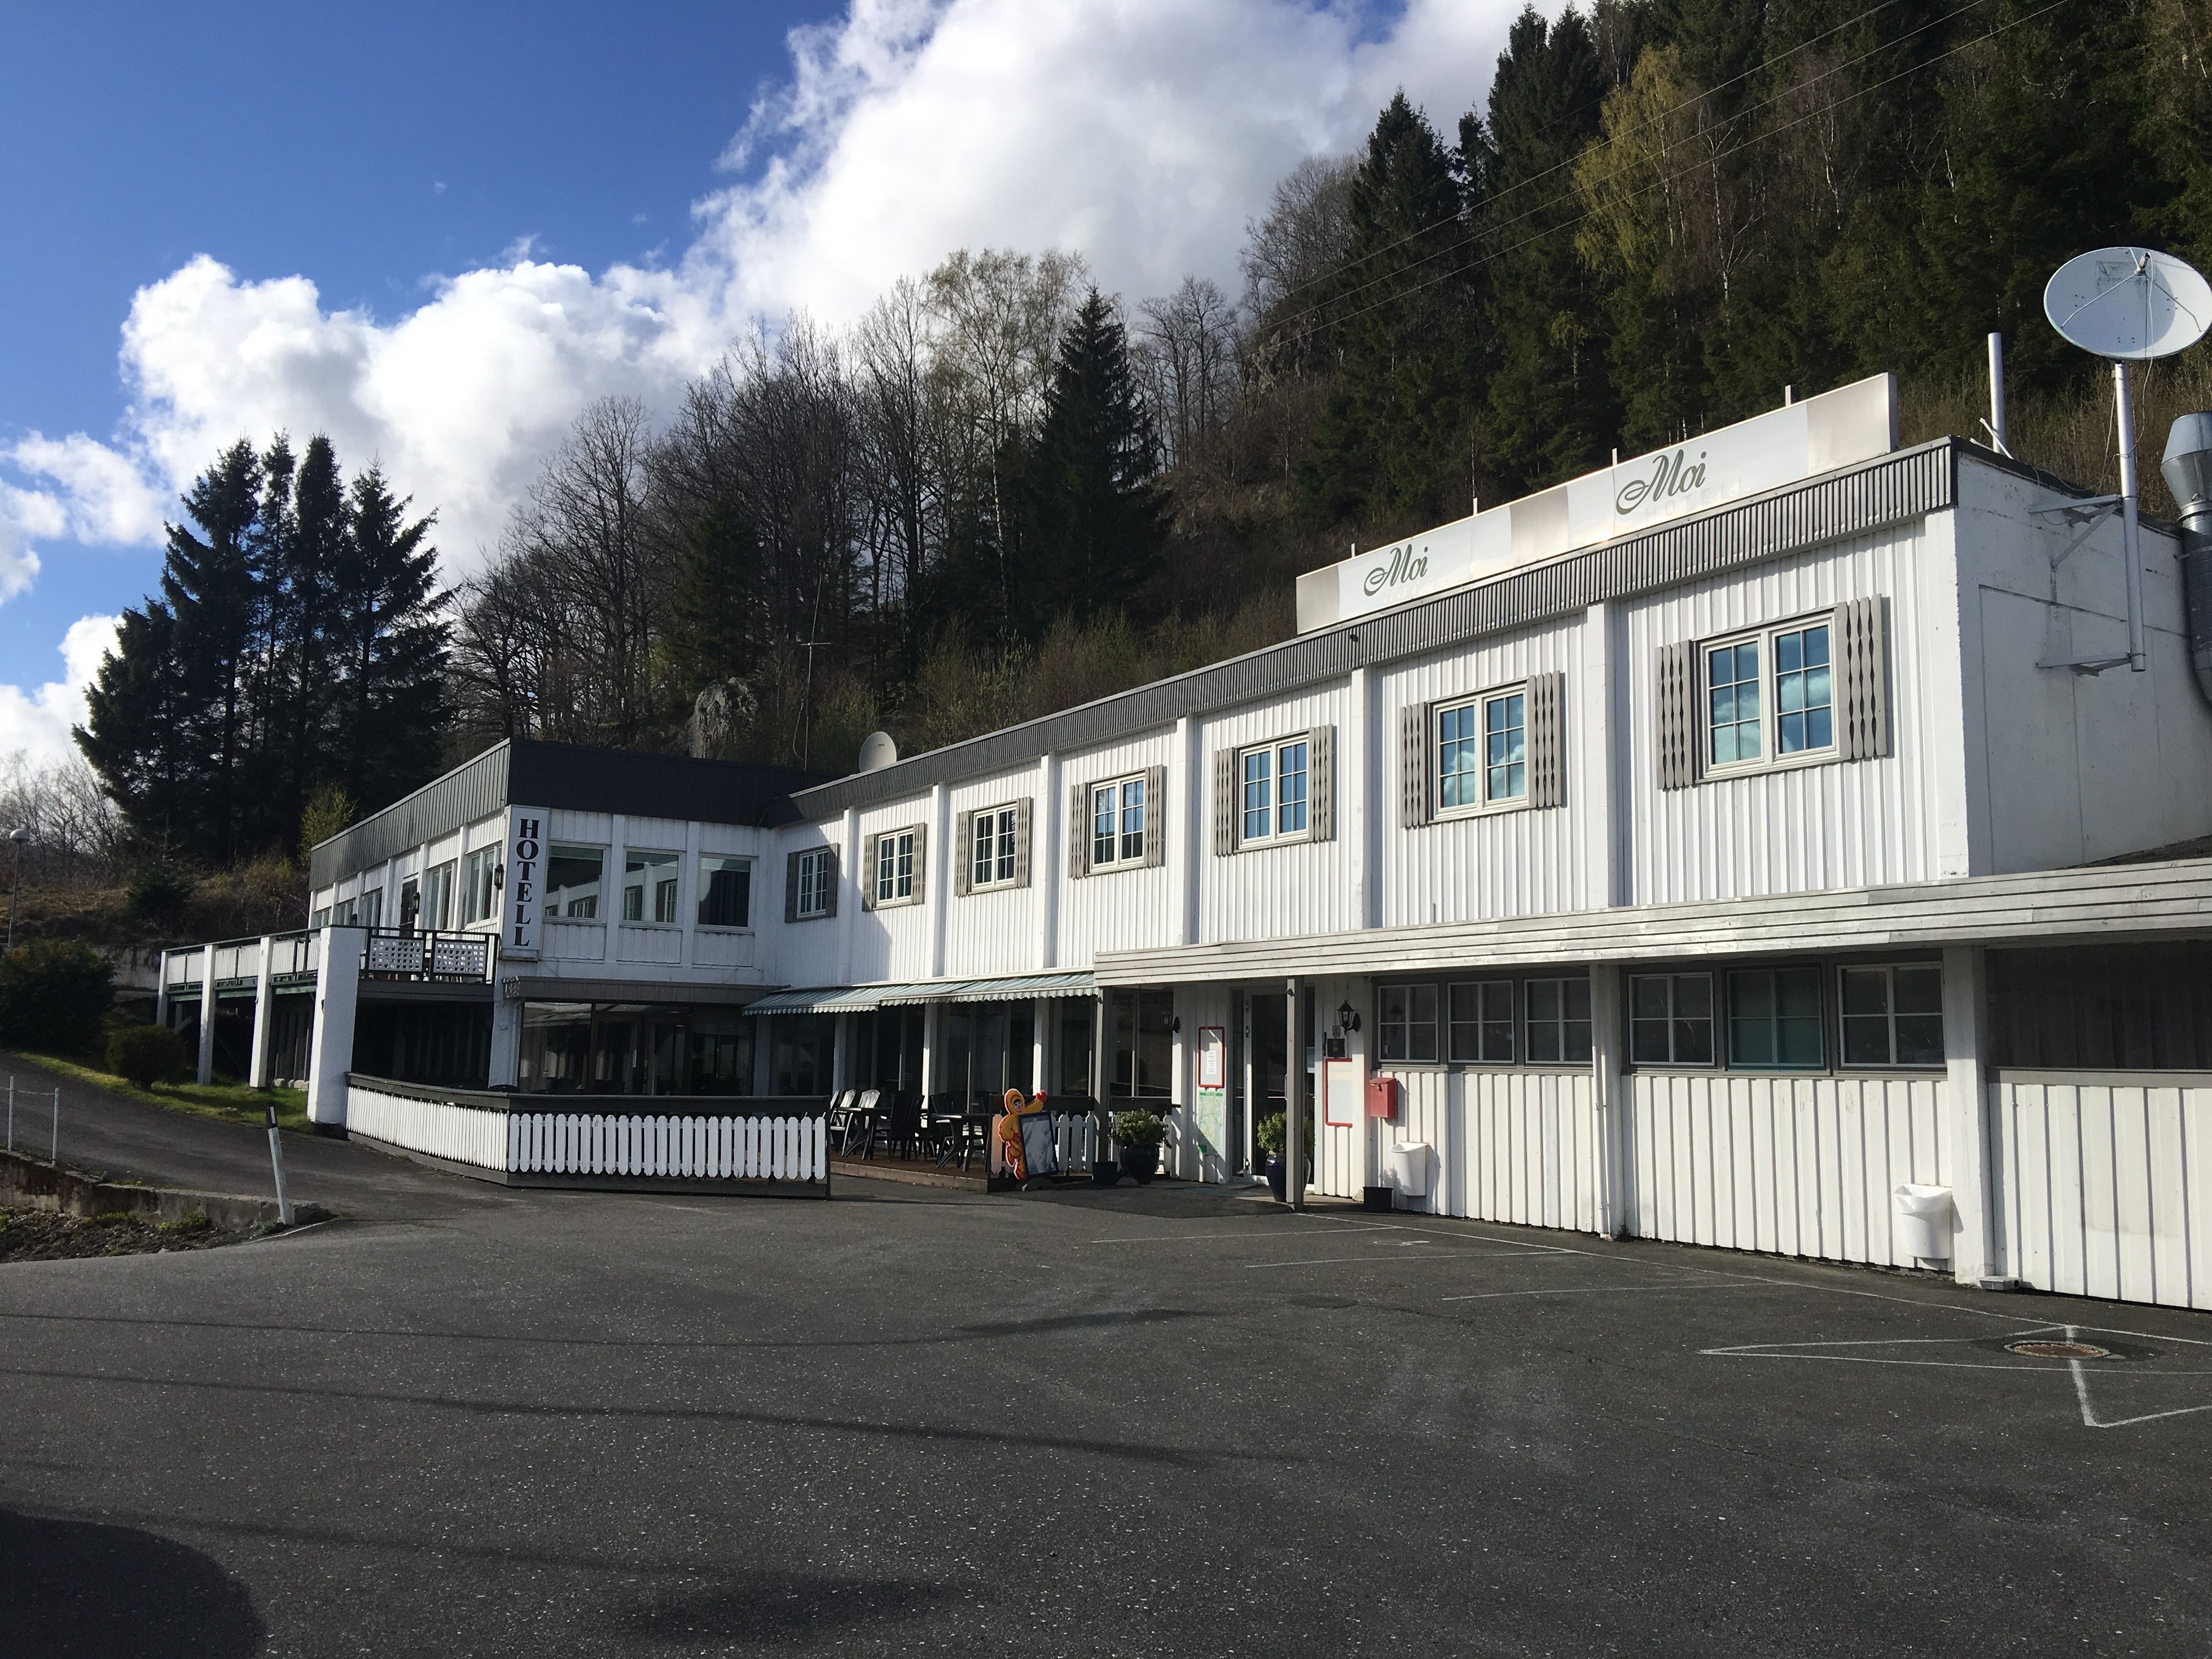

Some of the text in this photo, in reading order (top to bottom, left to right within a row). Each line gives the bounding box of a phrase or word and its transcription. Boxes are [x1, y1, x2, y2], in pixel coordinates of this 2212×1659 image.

[1616, 448, 1707, 515] Moi
[1363, 543, 1429, 597] Moi
[514, 818, 540, 947] HOTELL
